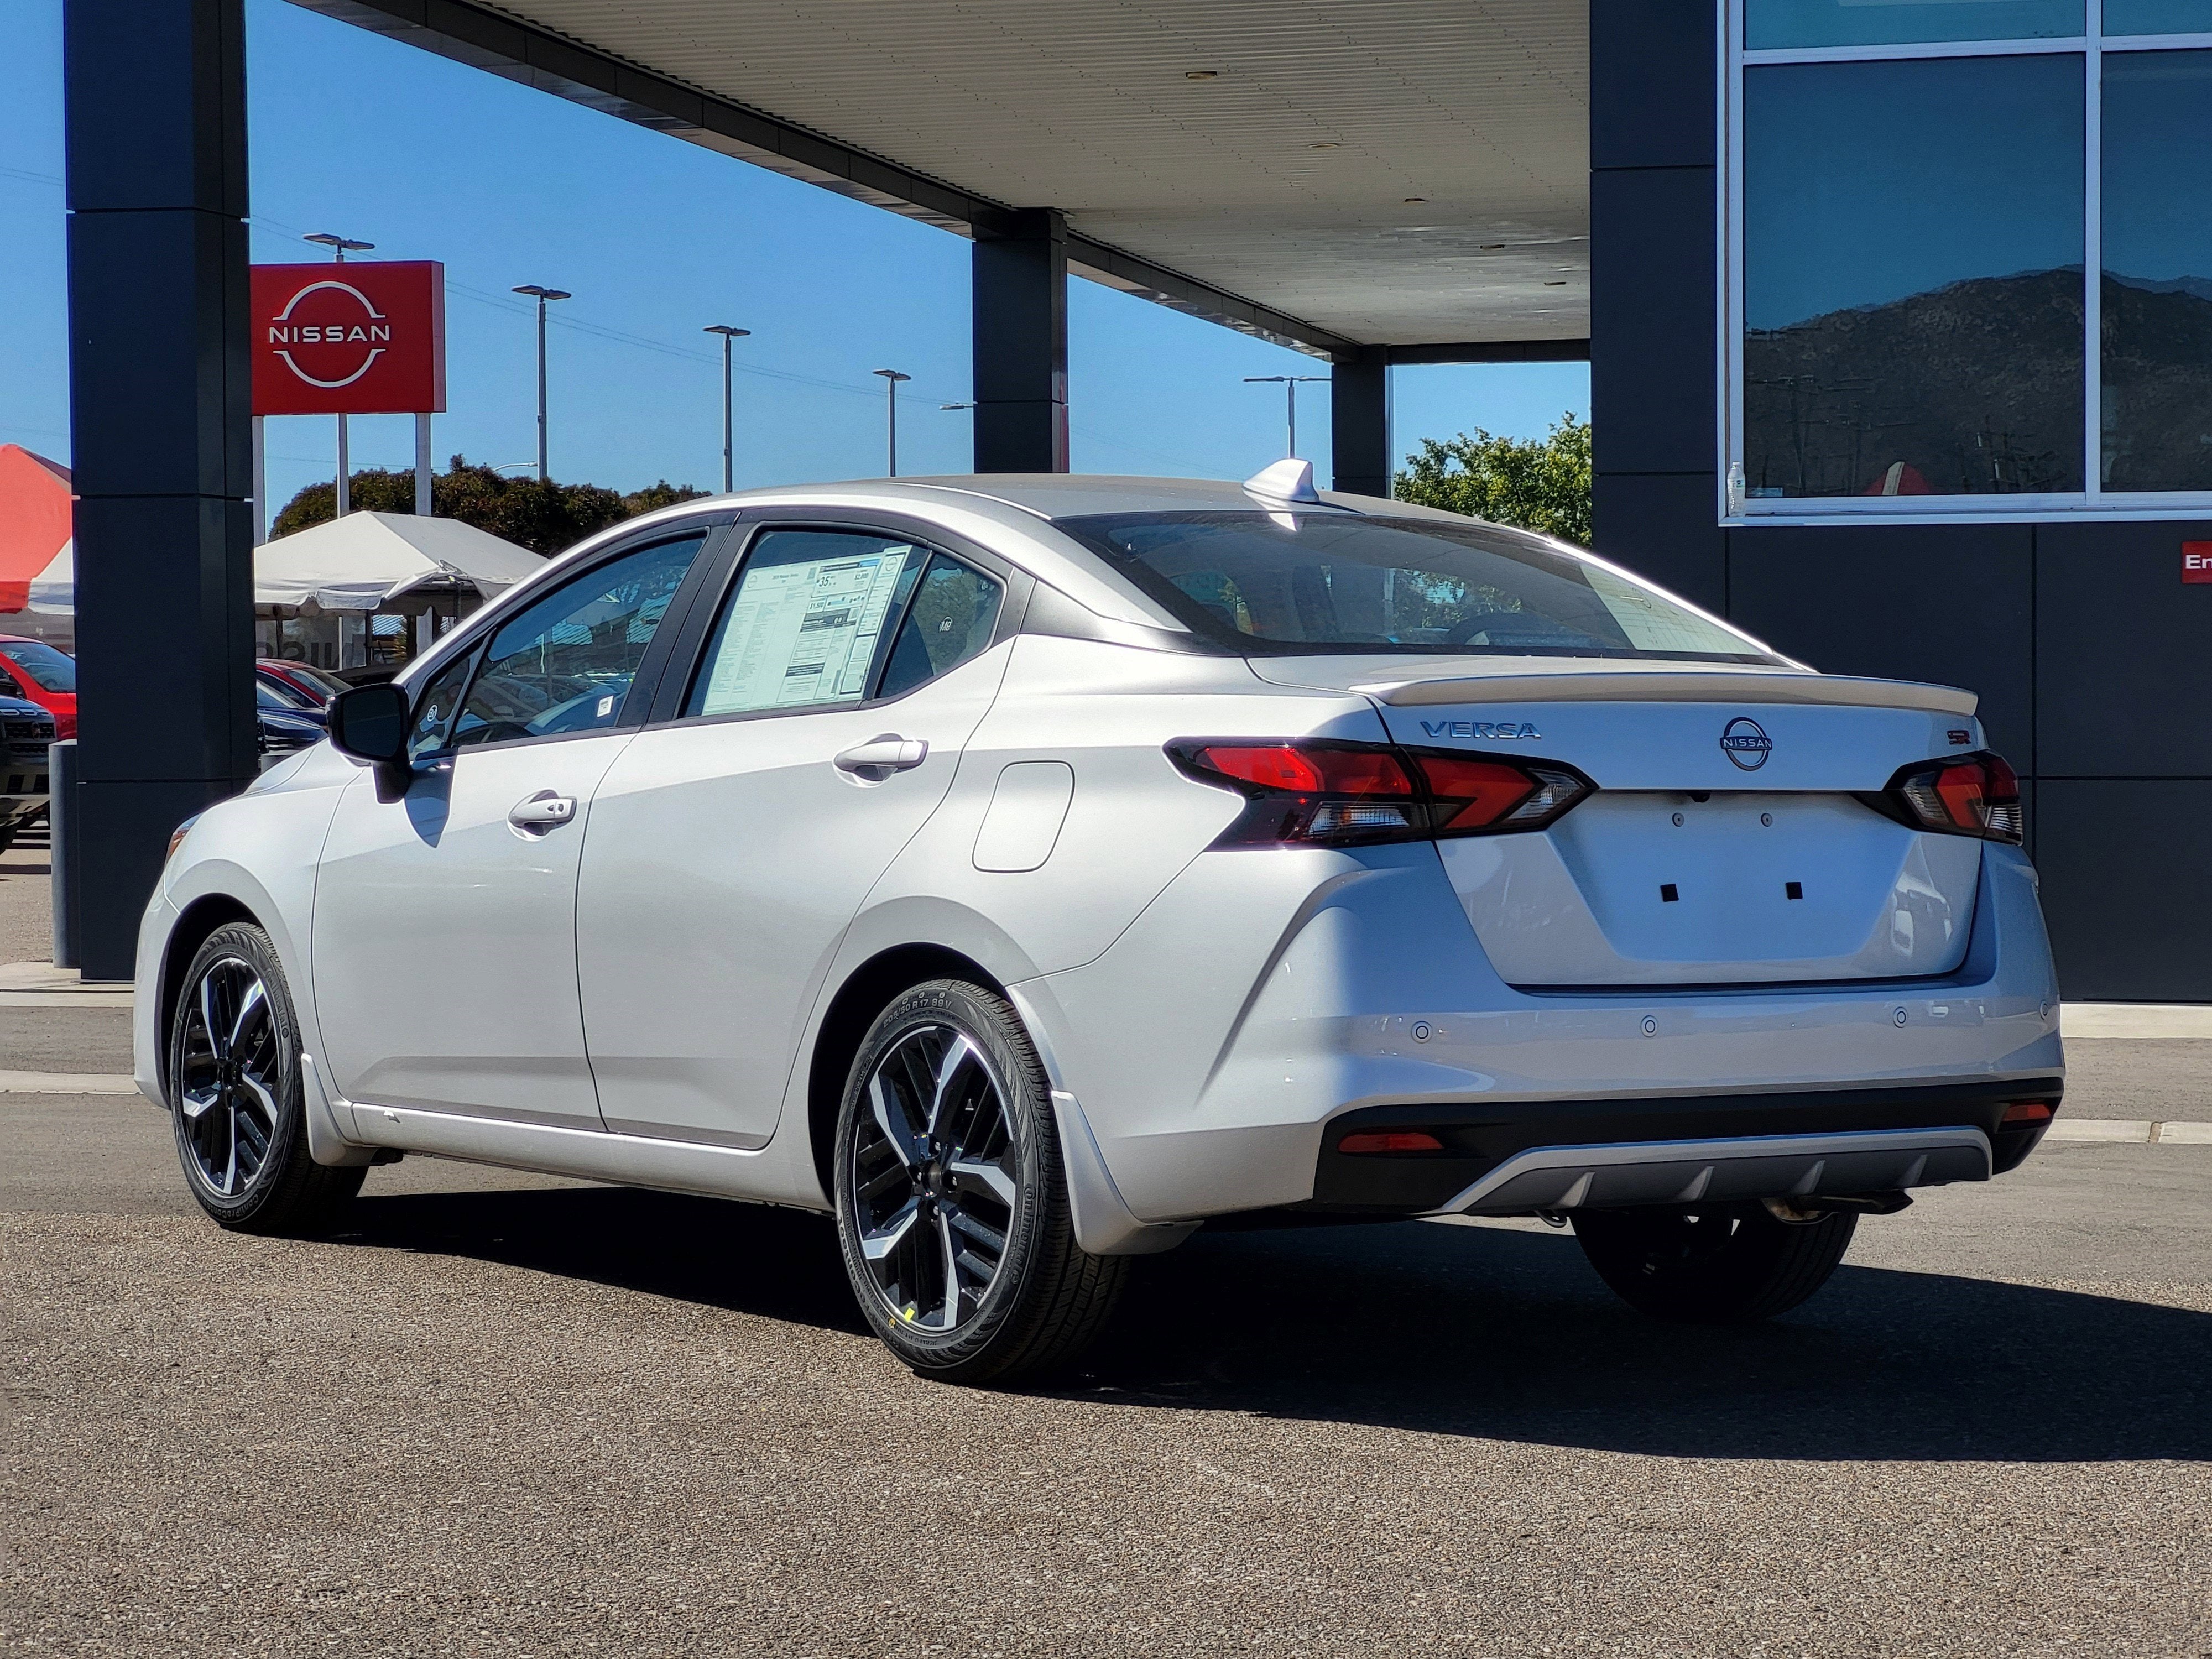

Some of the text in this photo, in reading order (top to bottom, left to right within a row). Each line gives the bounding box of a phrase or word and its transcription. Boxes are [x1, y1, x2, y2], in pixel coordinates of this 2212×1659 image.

[269, 325, 389, 343] NISSAN
[1420, 721, 1542, 739] VERSA
[1723, 739, 1772, 748] NISSAN
